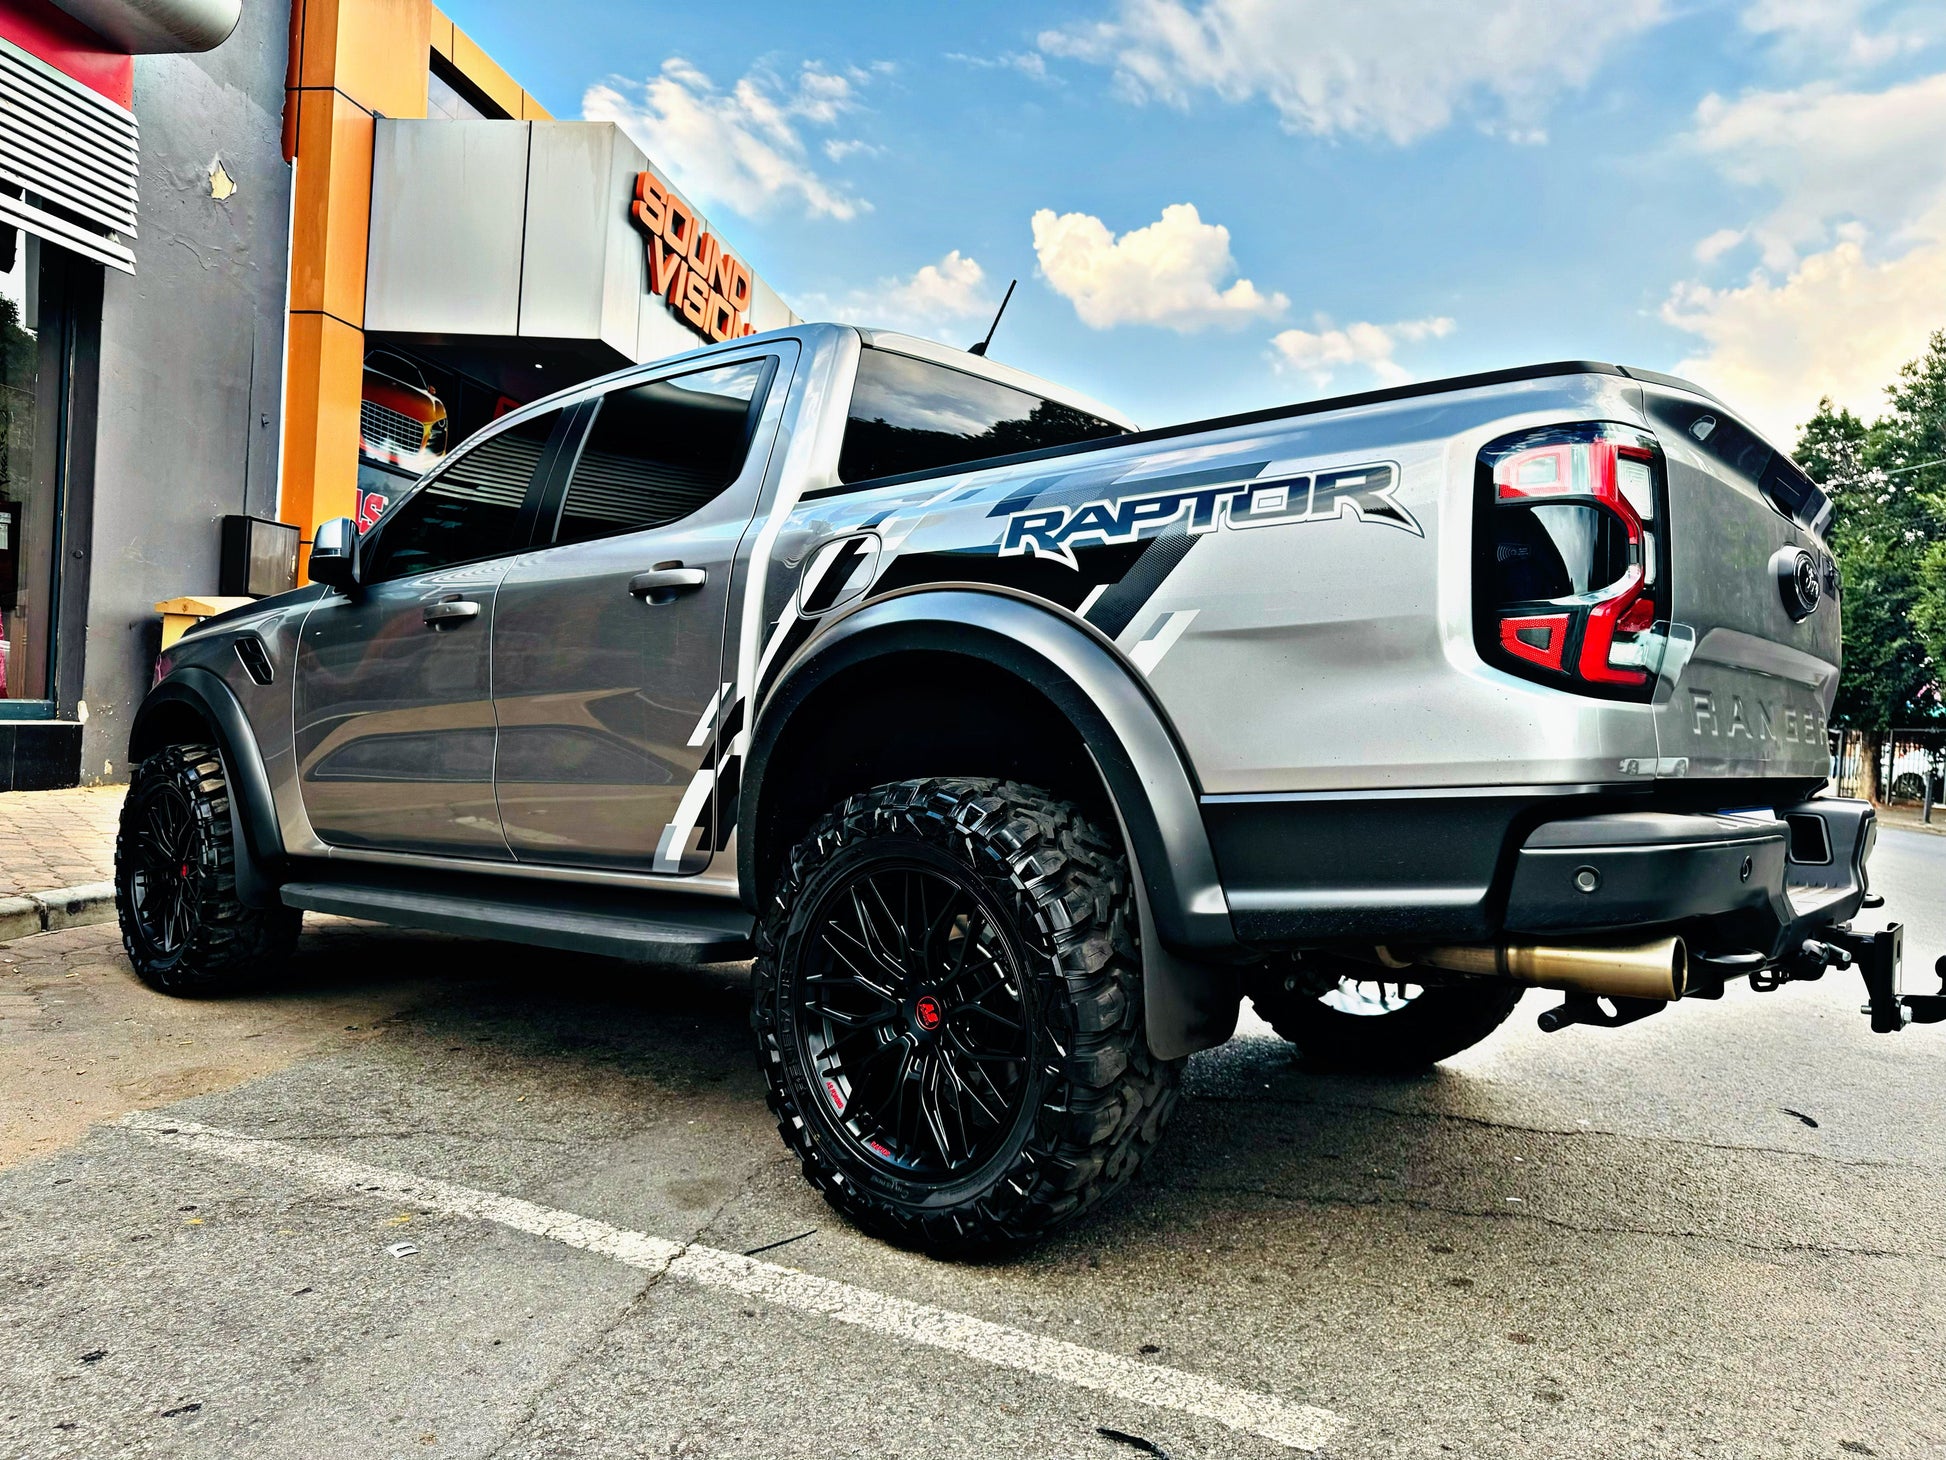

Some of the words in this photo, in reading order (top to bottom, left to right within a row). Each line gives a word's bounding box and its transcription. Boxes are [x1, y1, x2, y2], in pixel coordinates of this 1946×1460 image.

[632, 171, 751, 313] SOUND
[998, 460, 1425, 572] RAPTOR
[1688, 687, 1828, 746] RANGER
